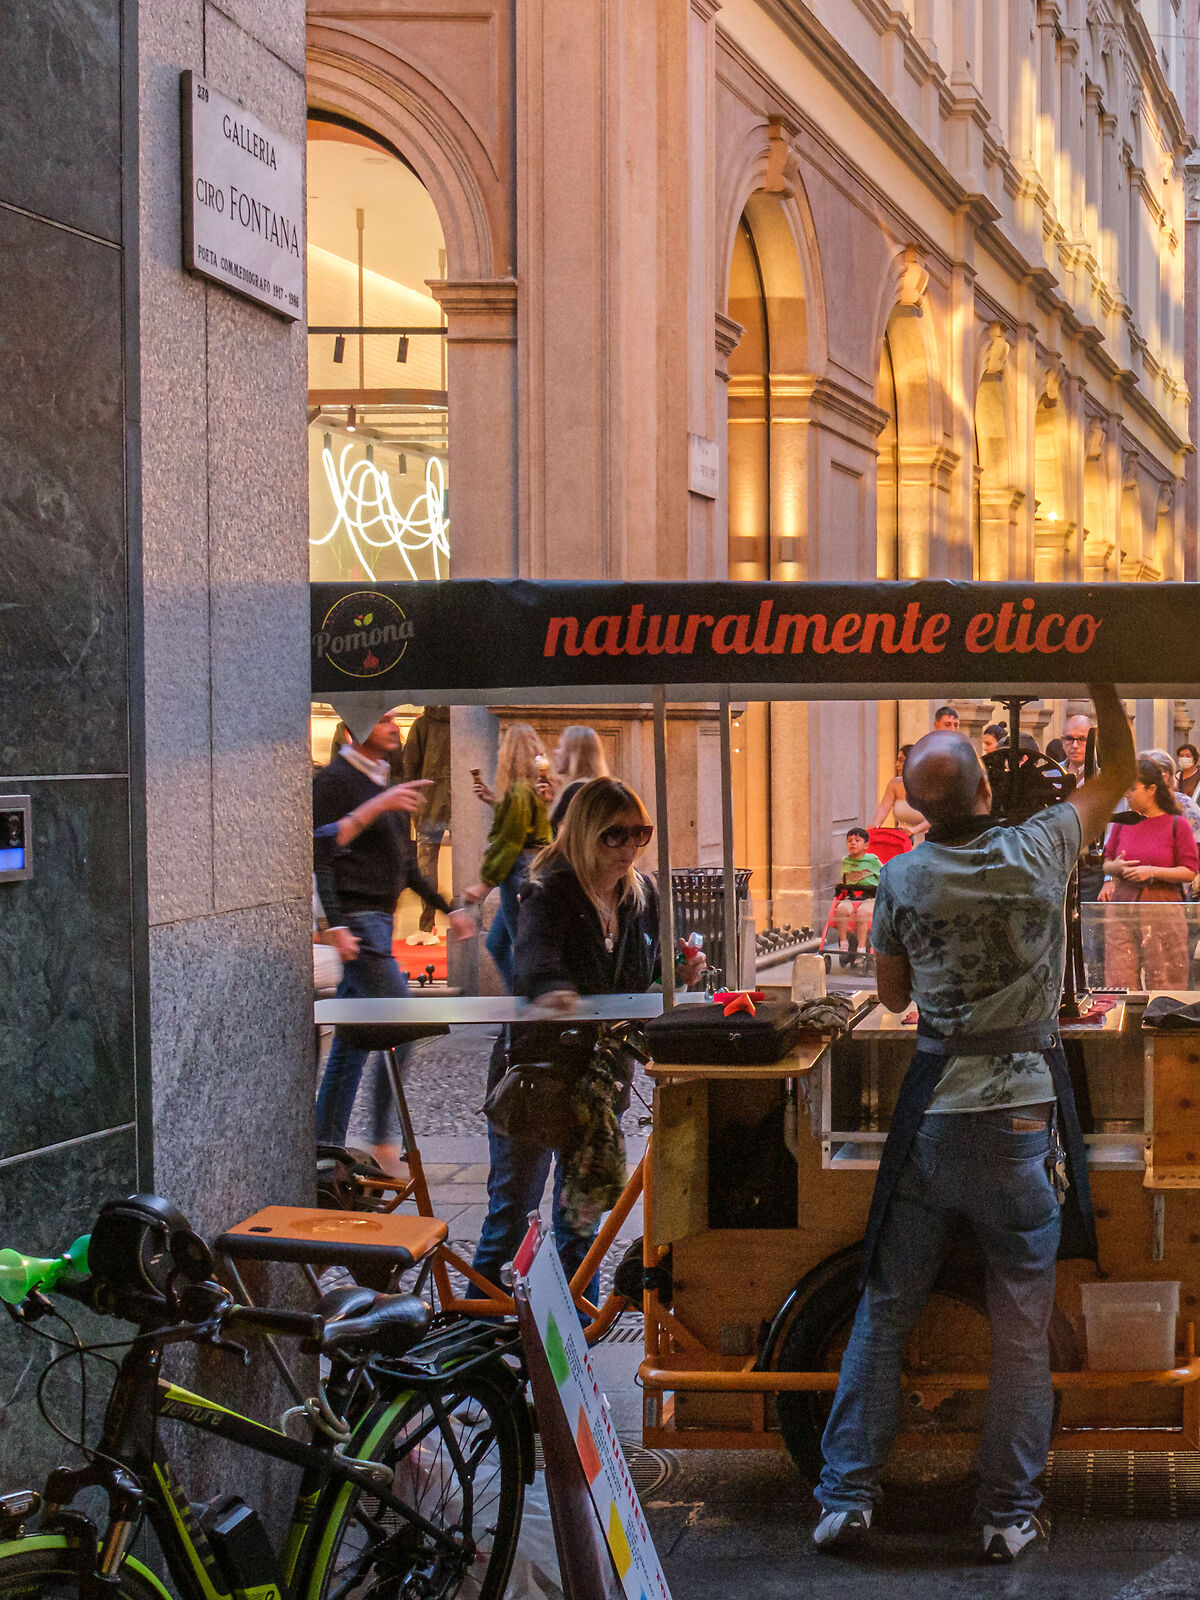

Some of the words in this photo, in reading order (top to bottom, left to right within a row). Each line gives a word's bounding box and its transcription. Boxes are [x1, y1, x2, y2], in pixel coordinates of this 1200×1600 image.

[222, 114, 277, 170] GALLERIA
[196, 178, 224, 213] CIRO
[230, 186, 300, 258] FONTANA
[198, 244, 218, 267] POETA
[220, 257, 270, 294] COMMEDIOGRAFO
[273, 284, 284, 300] 1917
[312, 619, 415, 658] Pomona
[543, 599, 951, 657] naturalmente
[964, 598, 1104, 654] etico
